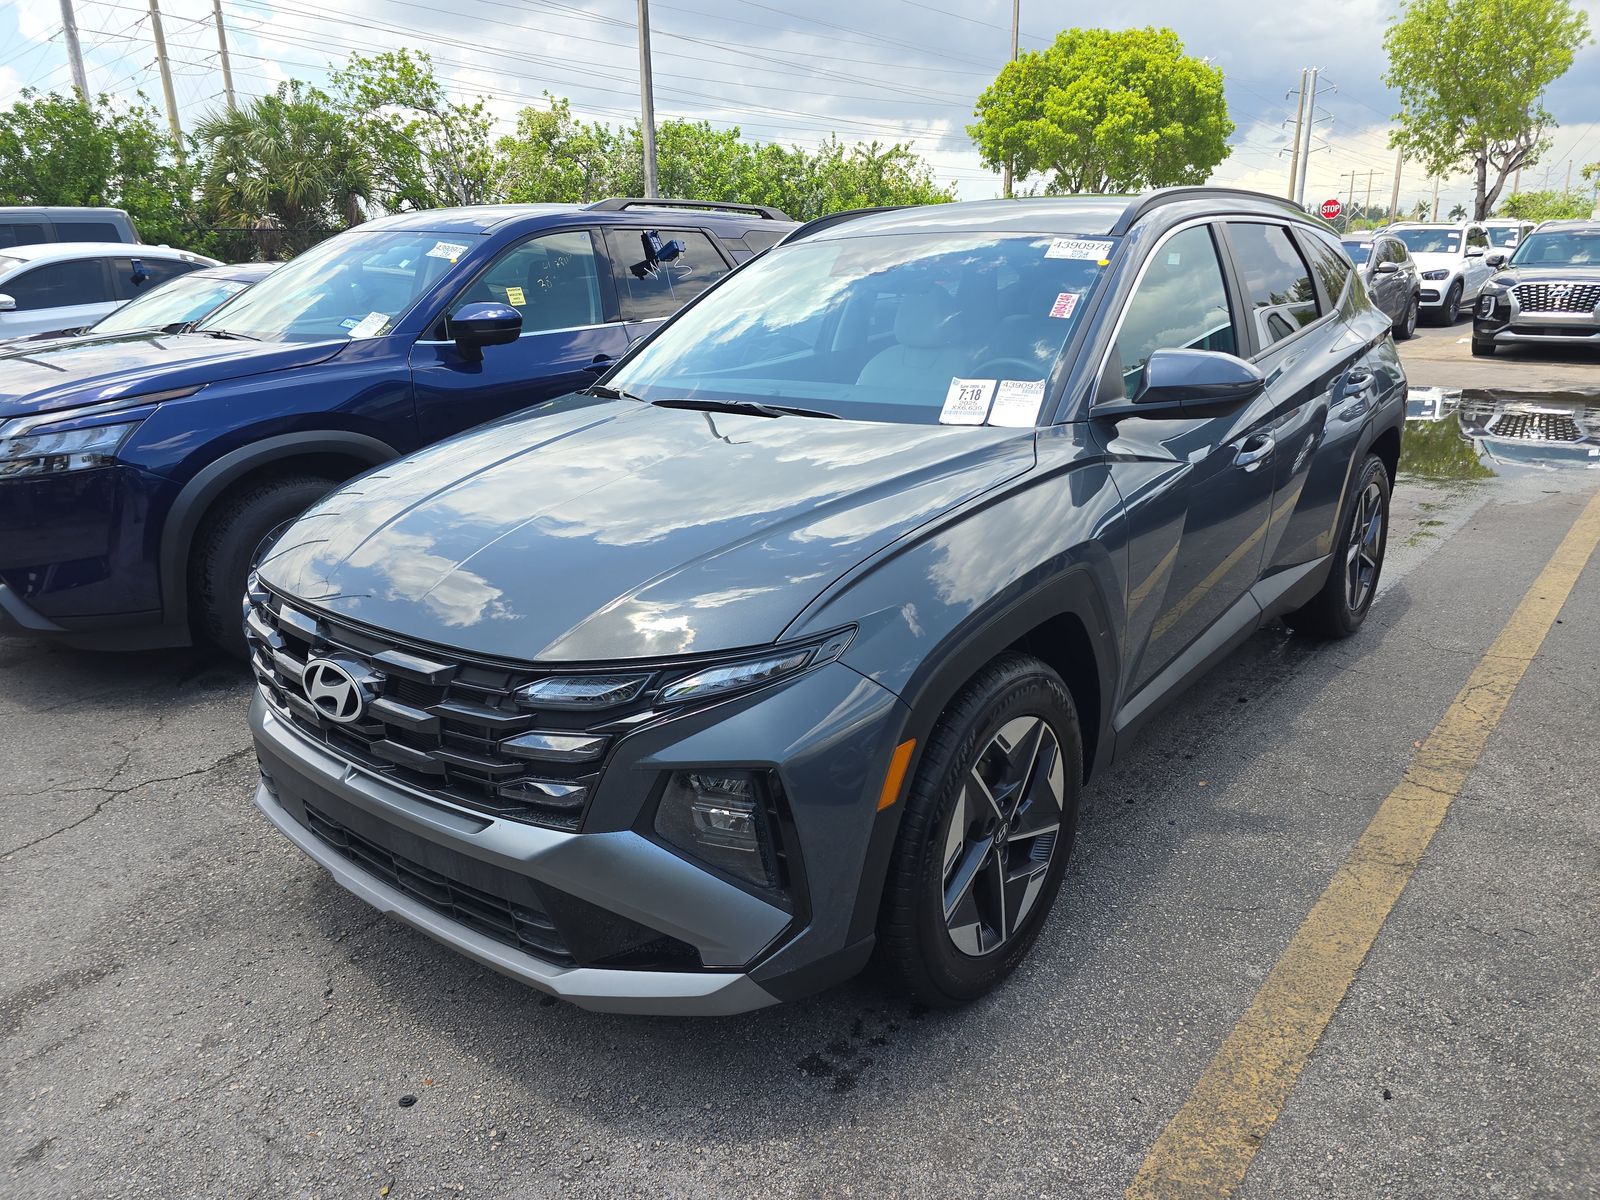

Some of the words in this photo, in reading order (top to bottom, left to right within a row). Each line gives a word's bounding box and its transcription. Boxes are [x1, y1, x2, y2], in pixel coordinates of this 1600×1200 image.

[1322, 205, 1340, 214] STOP
[1054, 241, 1112, 251] 4390978
[1003, 381, 1045, 390] 4390978
[958, 389, 982, 401] 7:18
